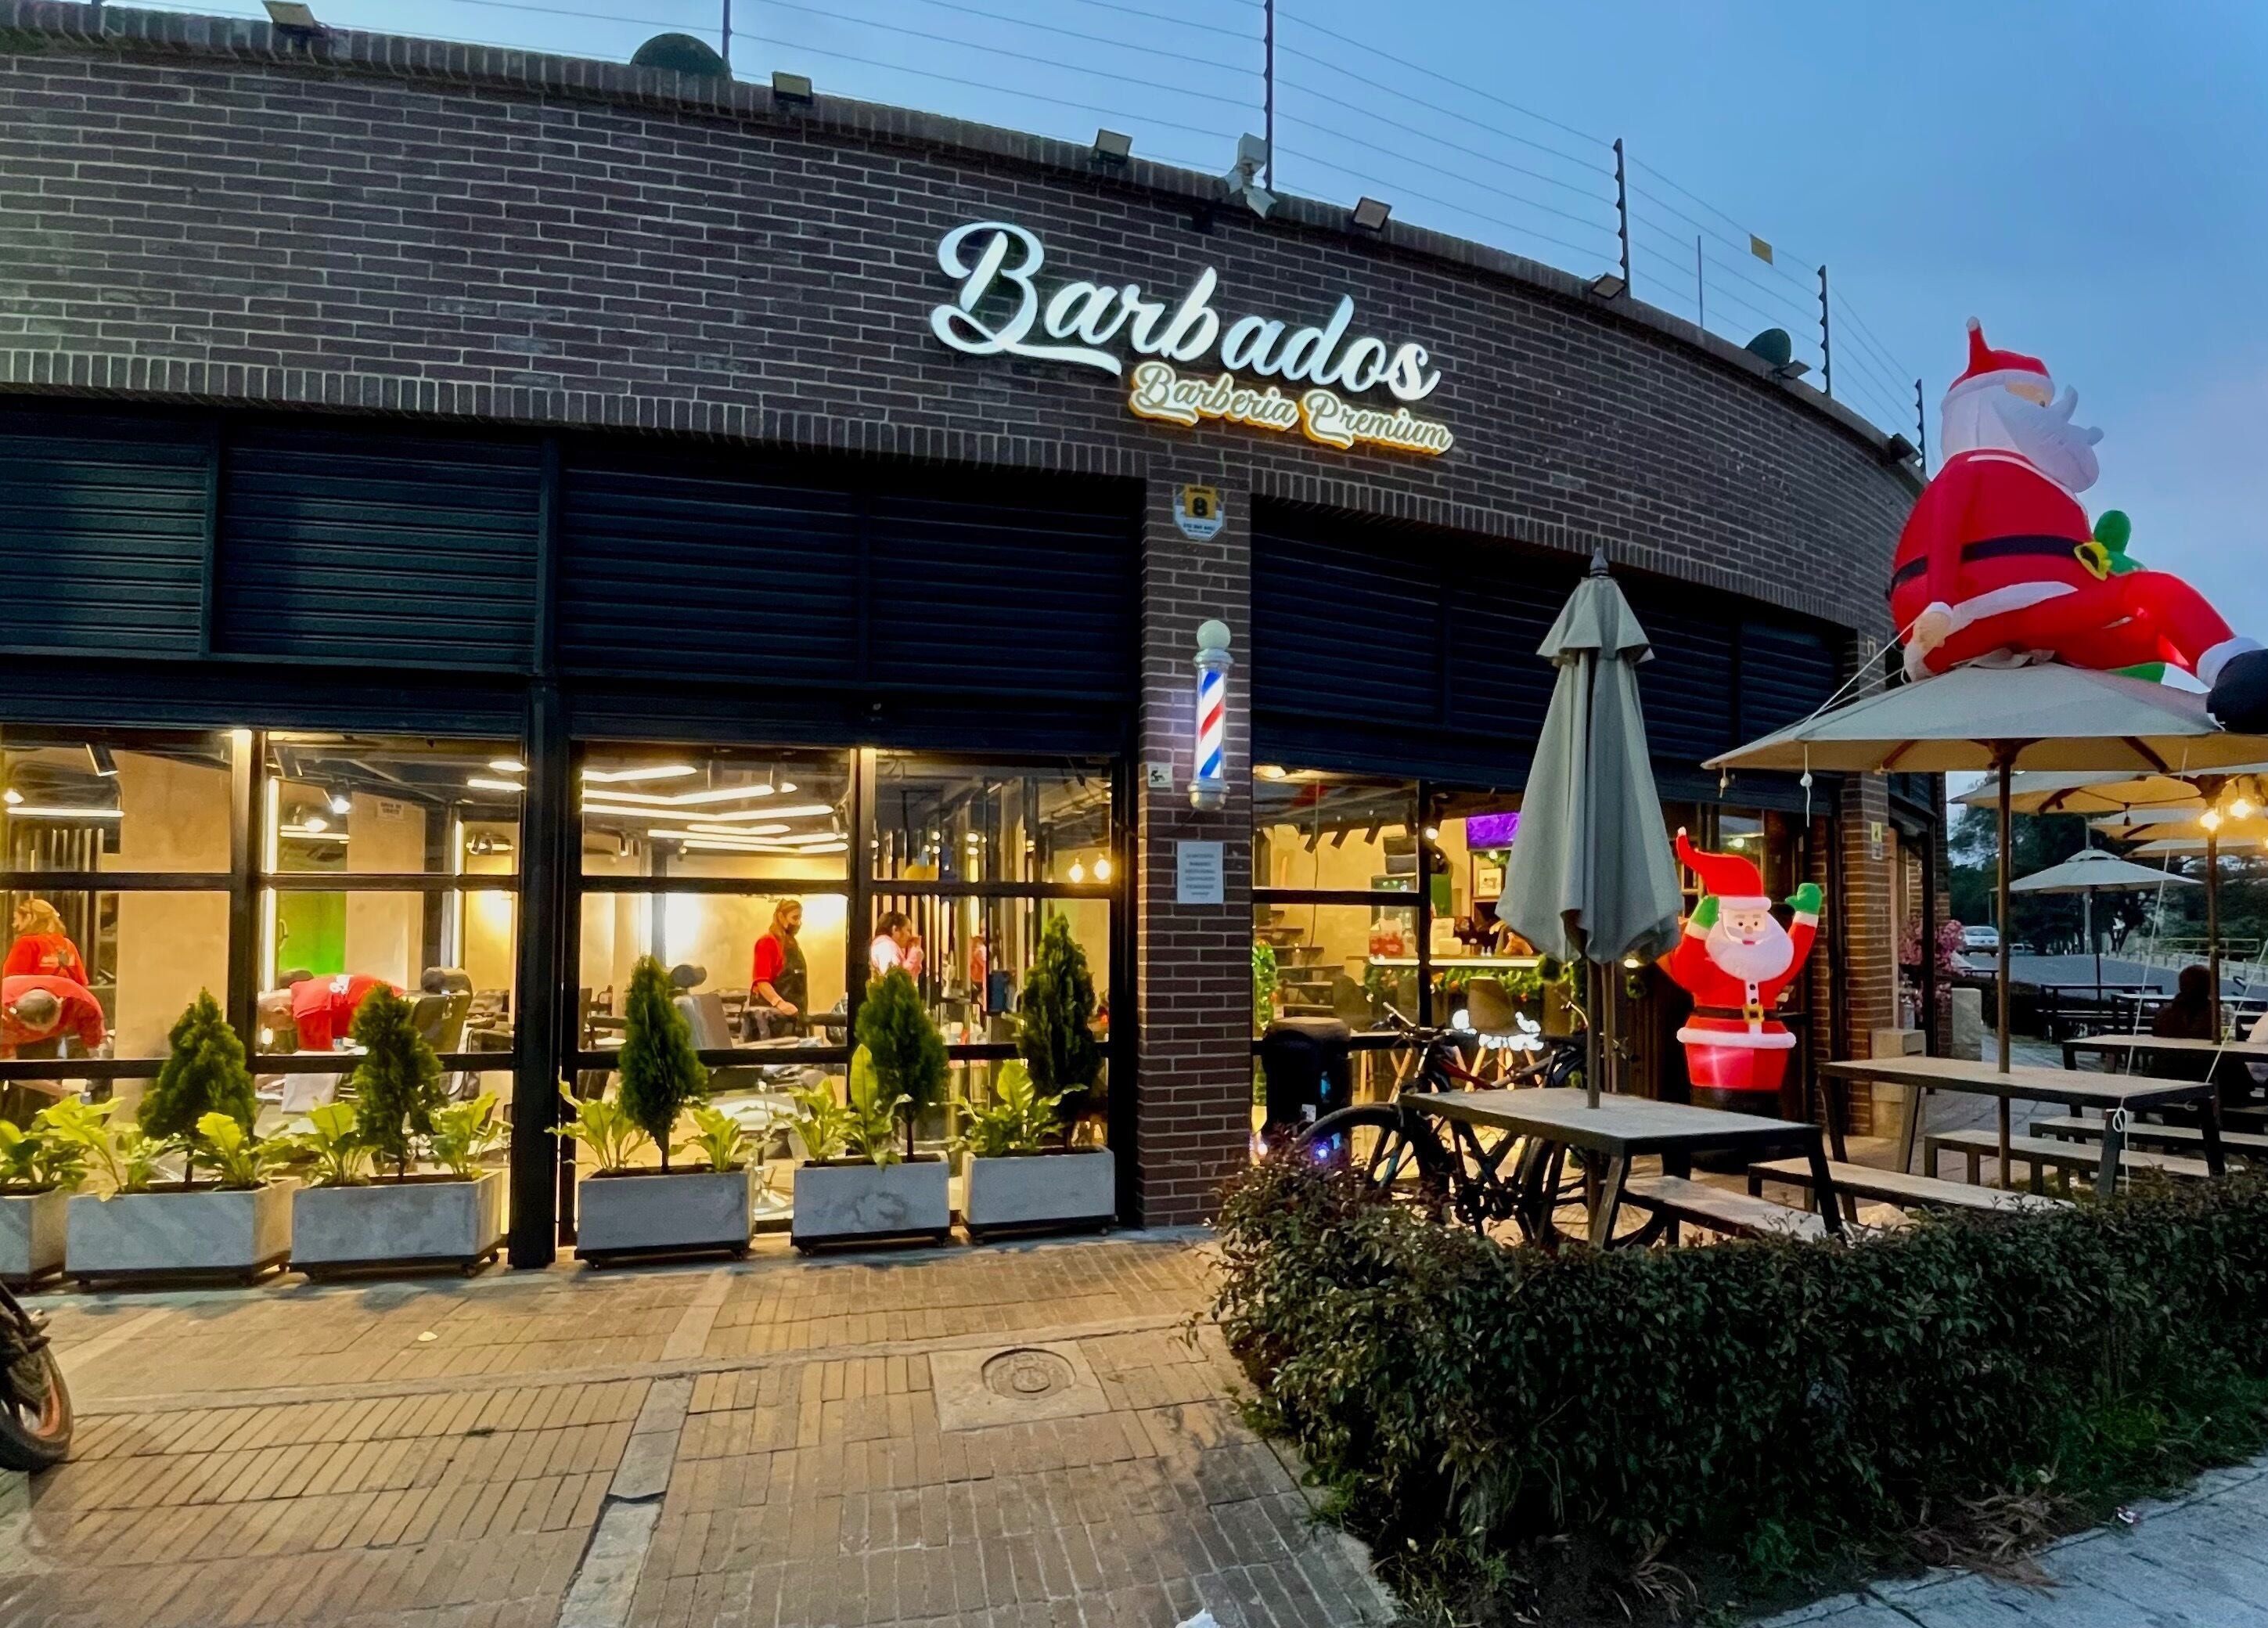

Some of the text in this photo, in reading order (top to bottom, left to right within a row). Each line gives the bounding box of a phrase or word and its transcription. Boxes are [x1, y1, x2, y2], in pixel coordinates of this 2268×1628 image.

[930, 221, 1441, 400] Barbados
[1131, 362, 1453, 451] Barberia Premium
